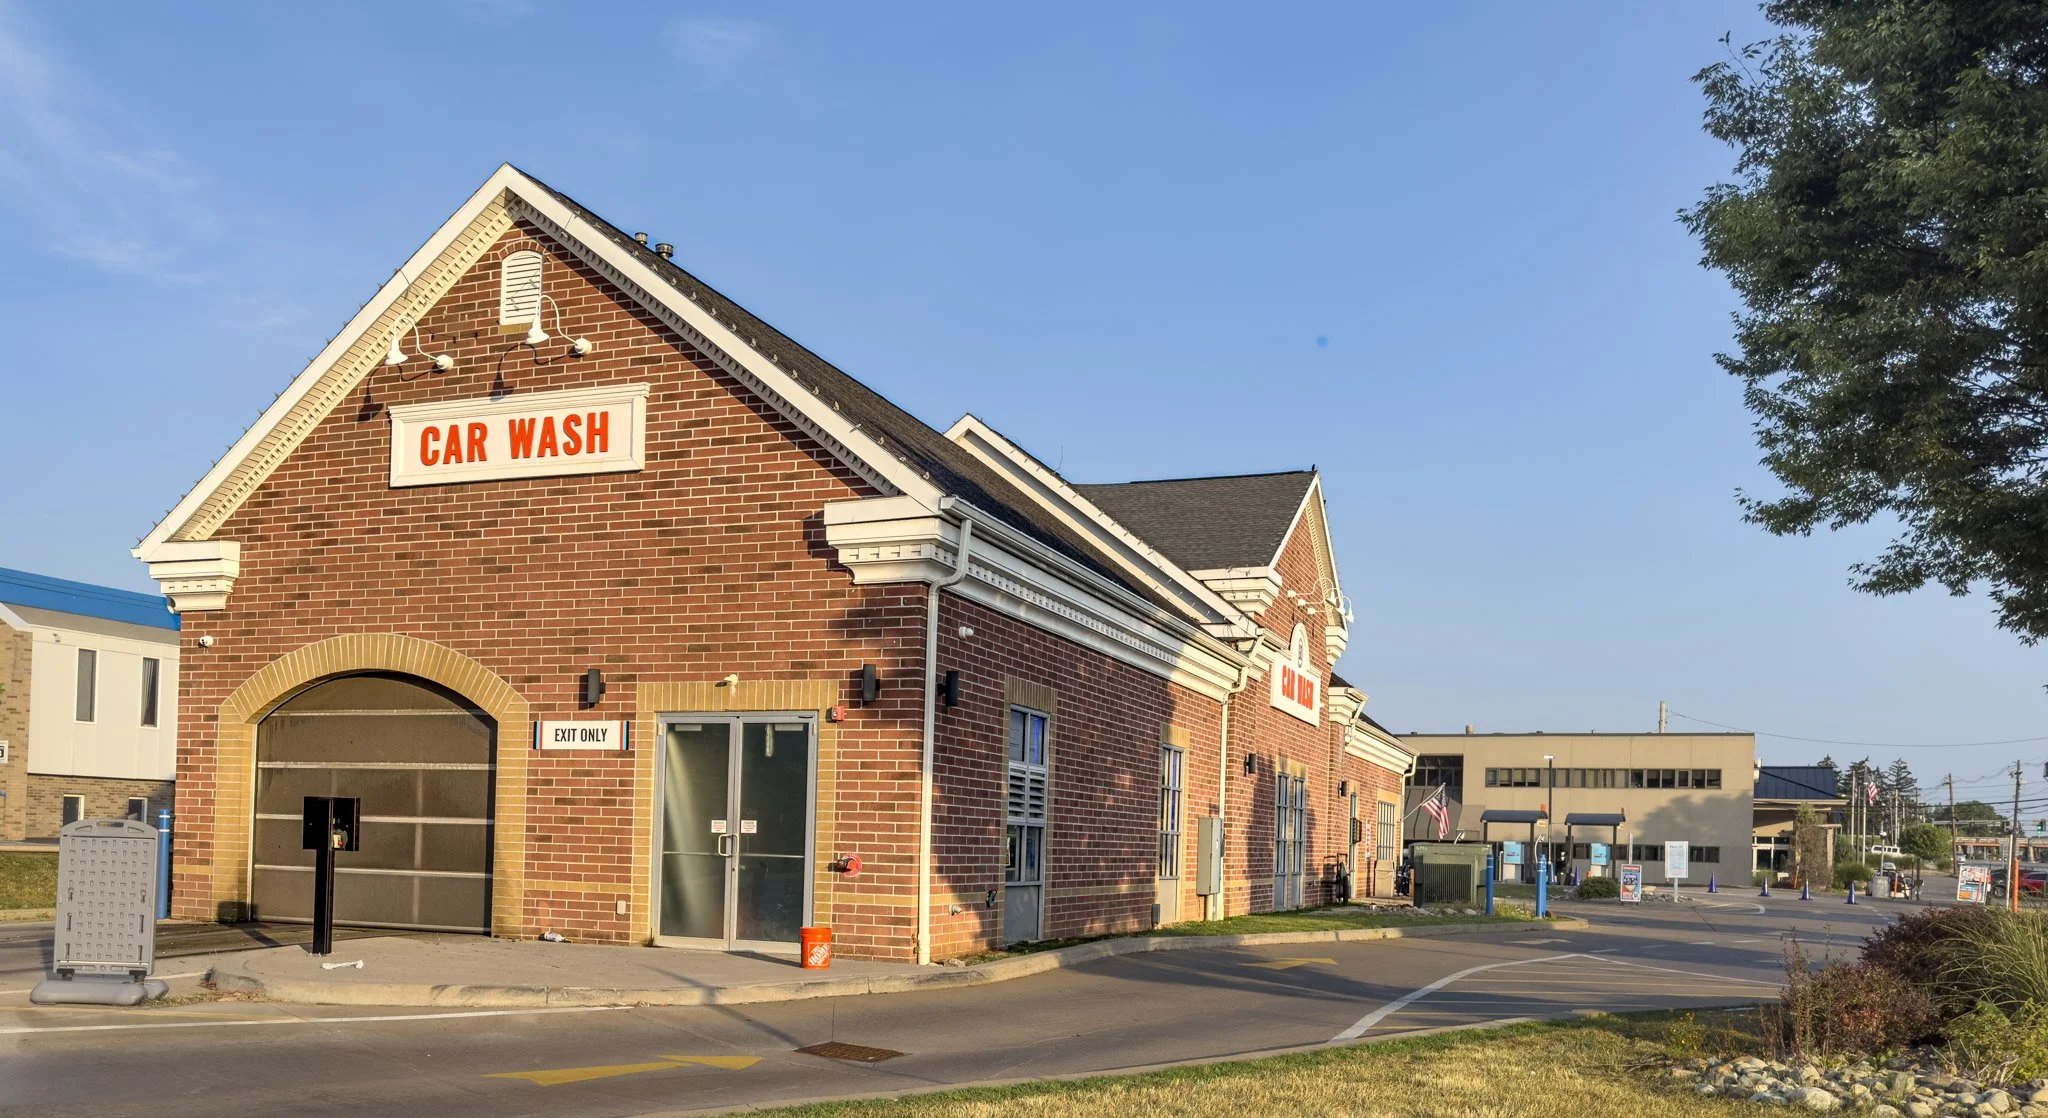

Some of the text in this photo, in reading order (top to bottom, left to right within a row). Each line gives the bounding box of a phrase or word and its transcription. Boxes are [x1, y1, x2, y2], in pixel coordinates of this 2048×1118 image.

[420, 411, 609, 466] CAR WASH
[1282, 665, 1314, 710] CAR WASH
[554, 728, 607, 742] EXIT ONLY
